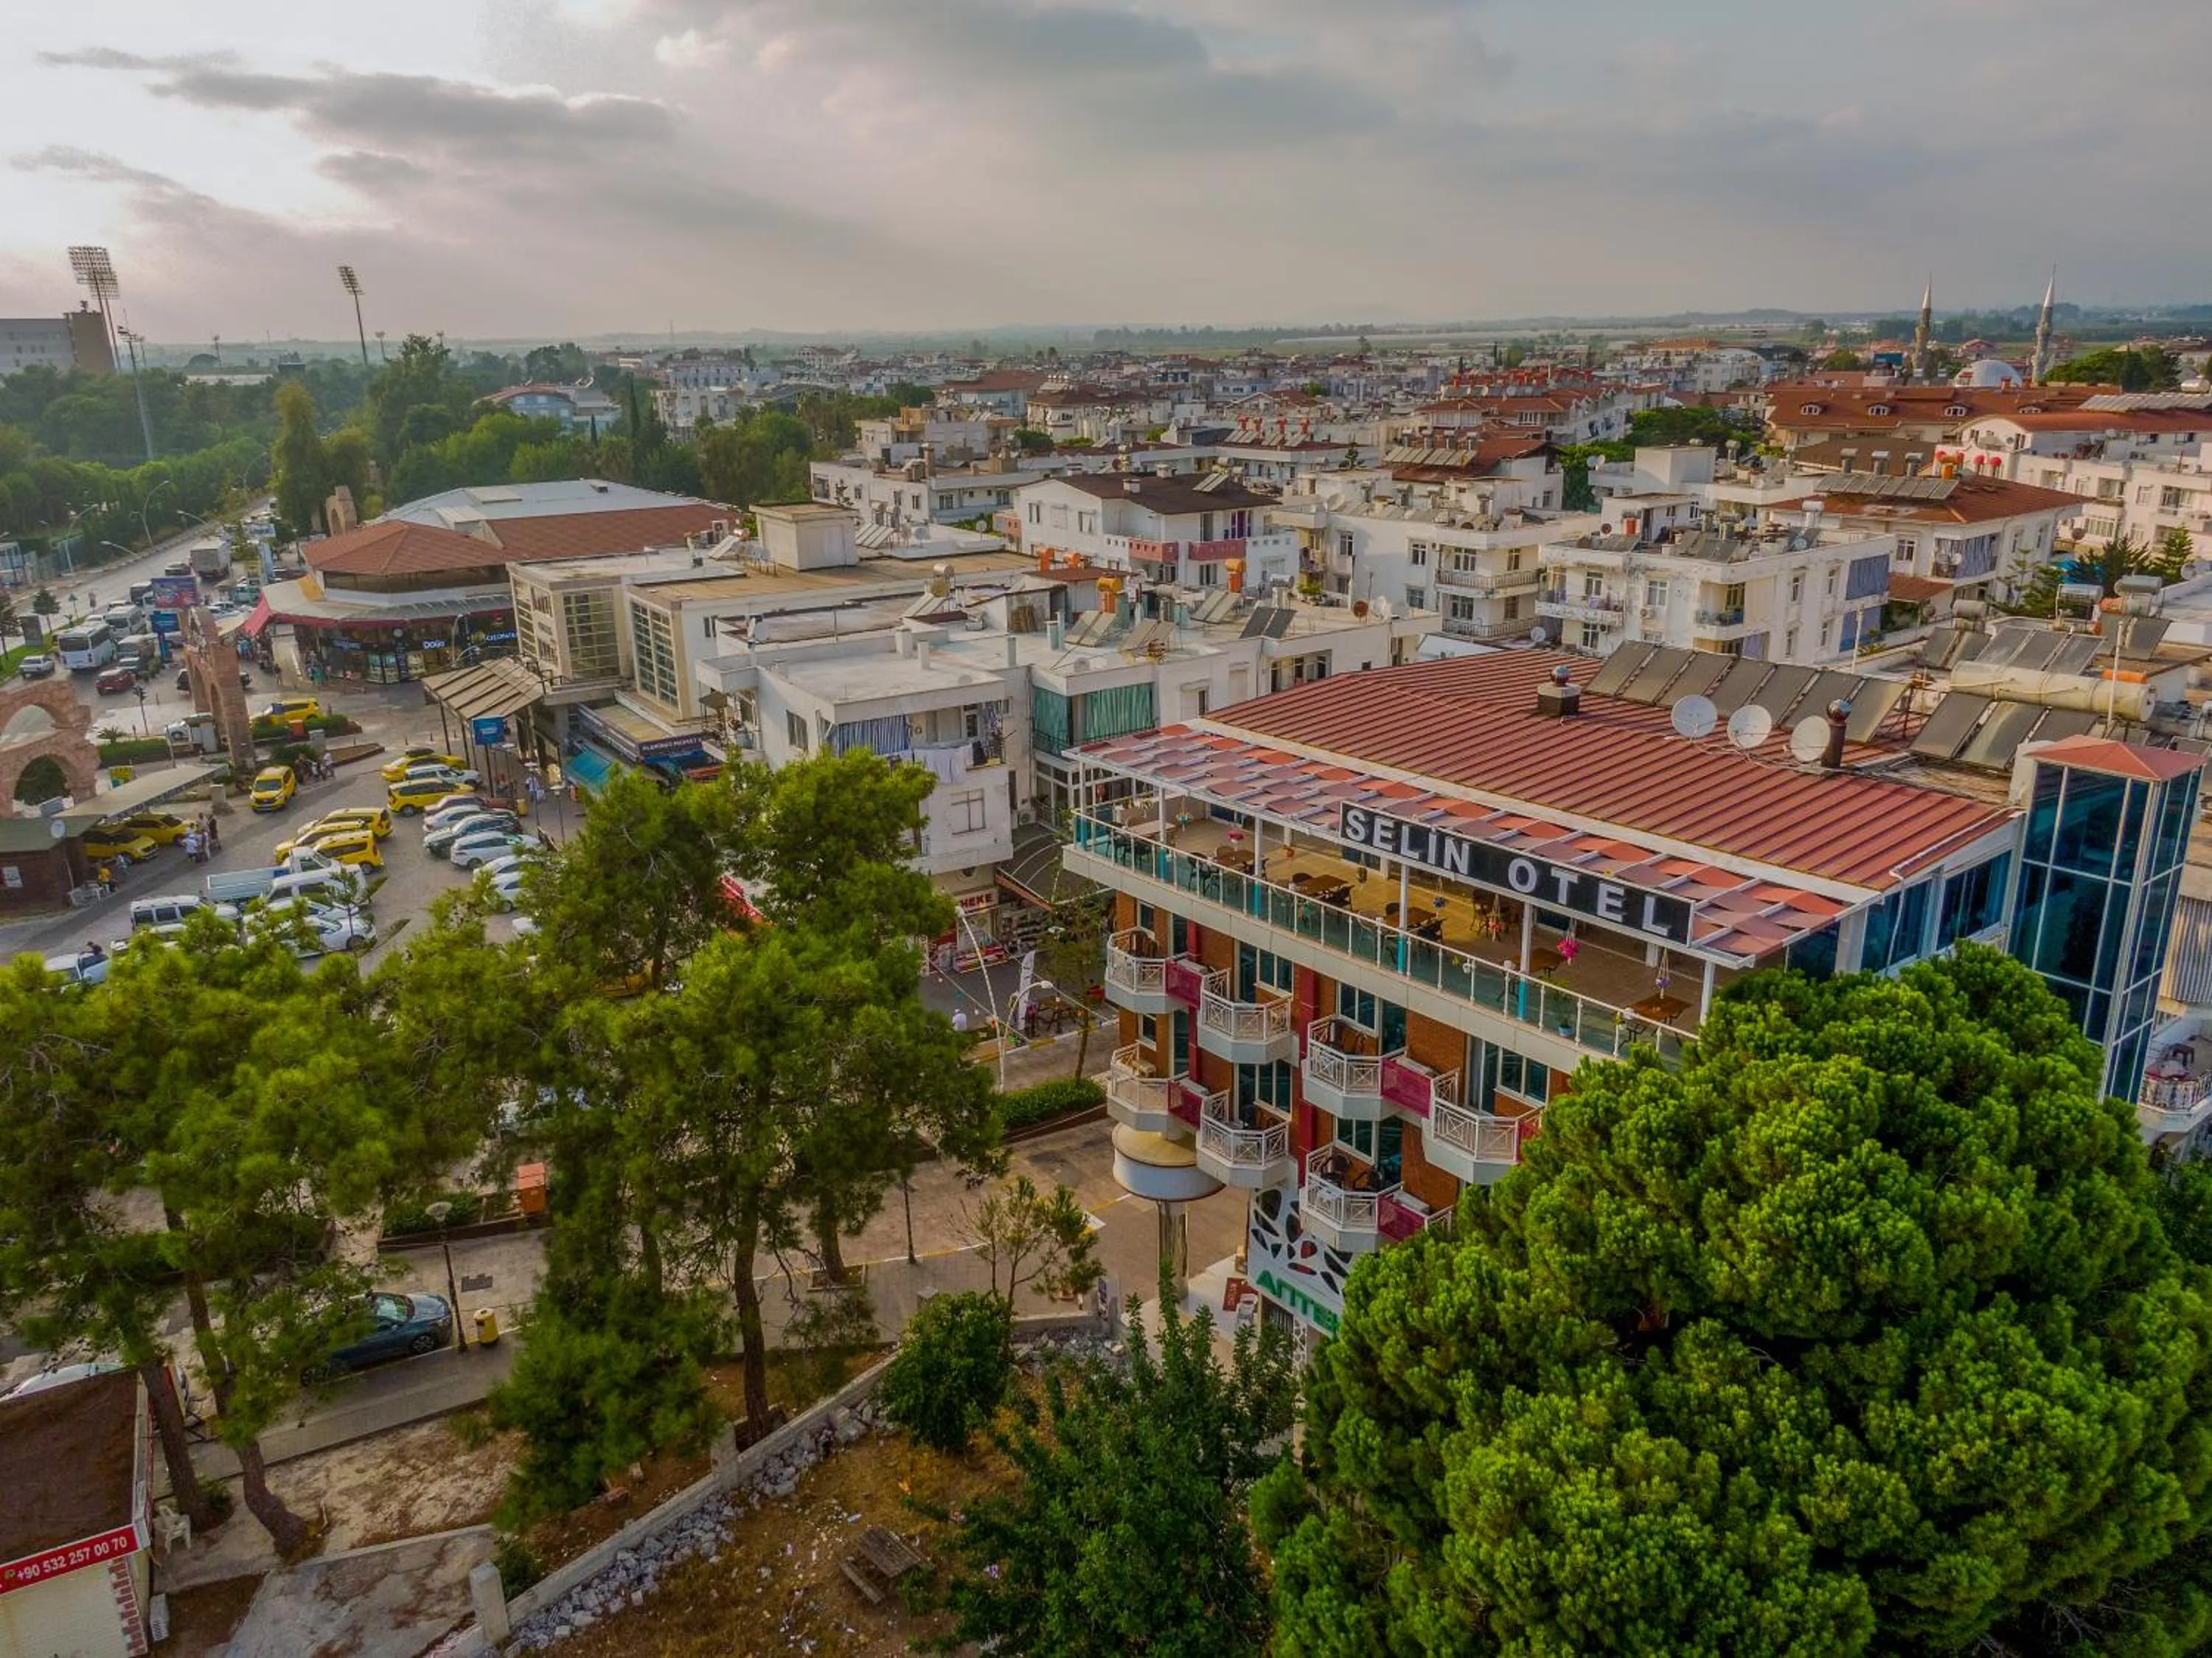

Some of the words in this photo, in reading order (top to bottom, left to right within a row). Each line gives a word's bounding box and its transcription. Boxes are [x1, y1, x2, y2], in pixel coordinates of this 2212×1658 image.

[960, 892, 992, 909] HEKE
[1508, 857, 1672, 937] OTEL
[17, 1564, 40, 1581] +90
[42, 1555, 67, 1574] 532
[68, 1547, 90, 1565] 257
[94, 1541, 110, 1557] 00
[111, 1536, 128, 1551] 70
